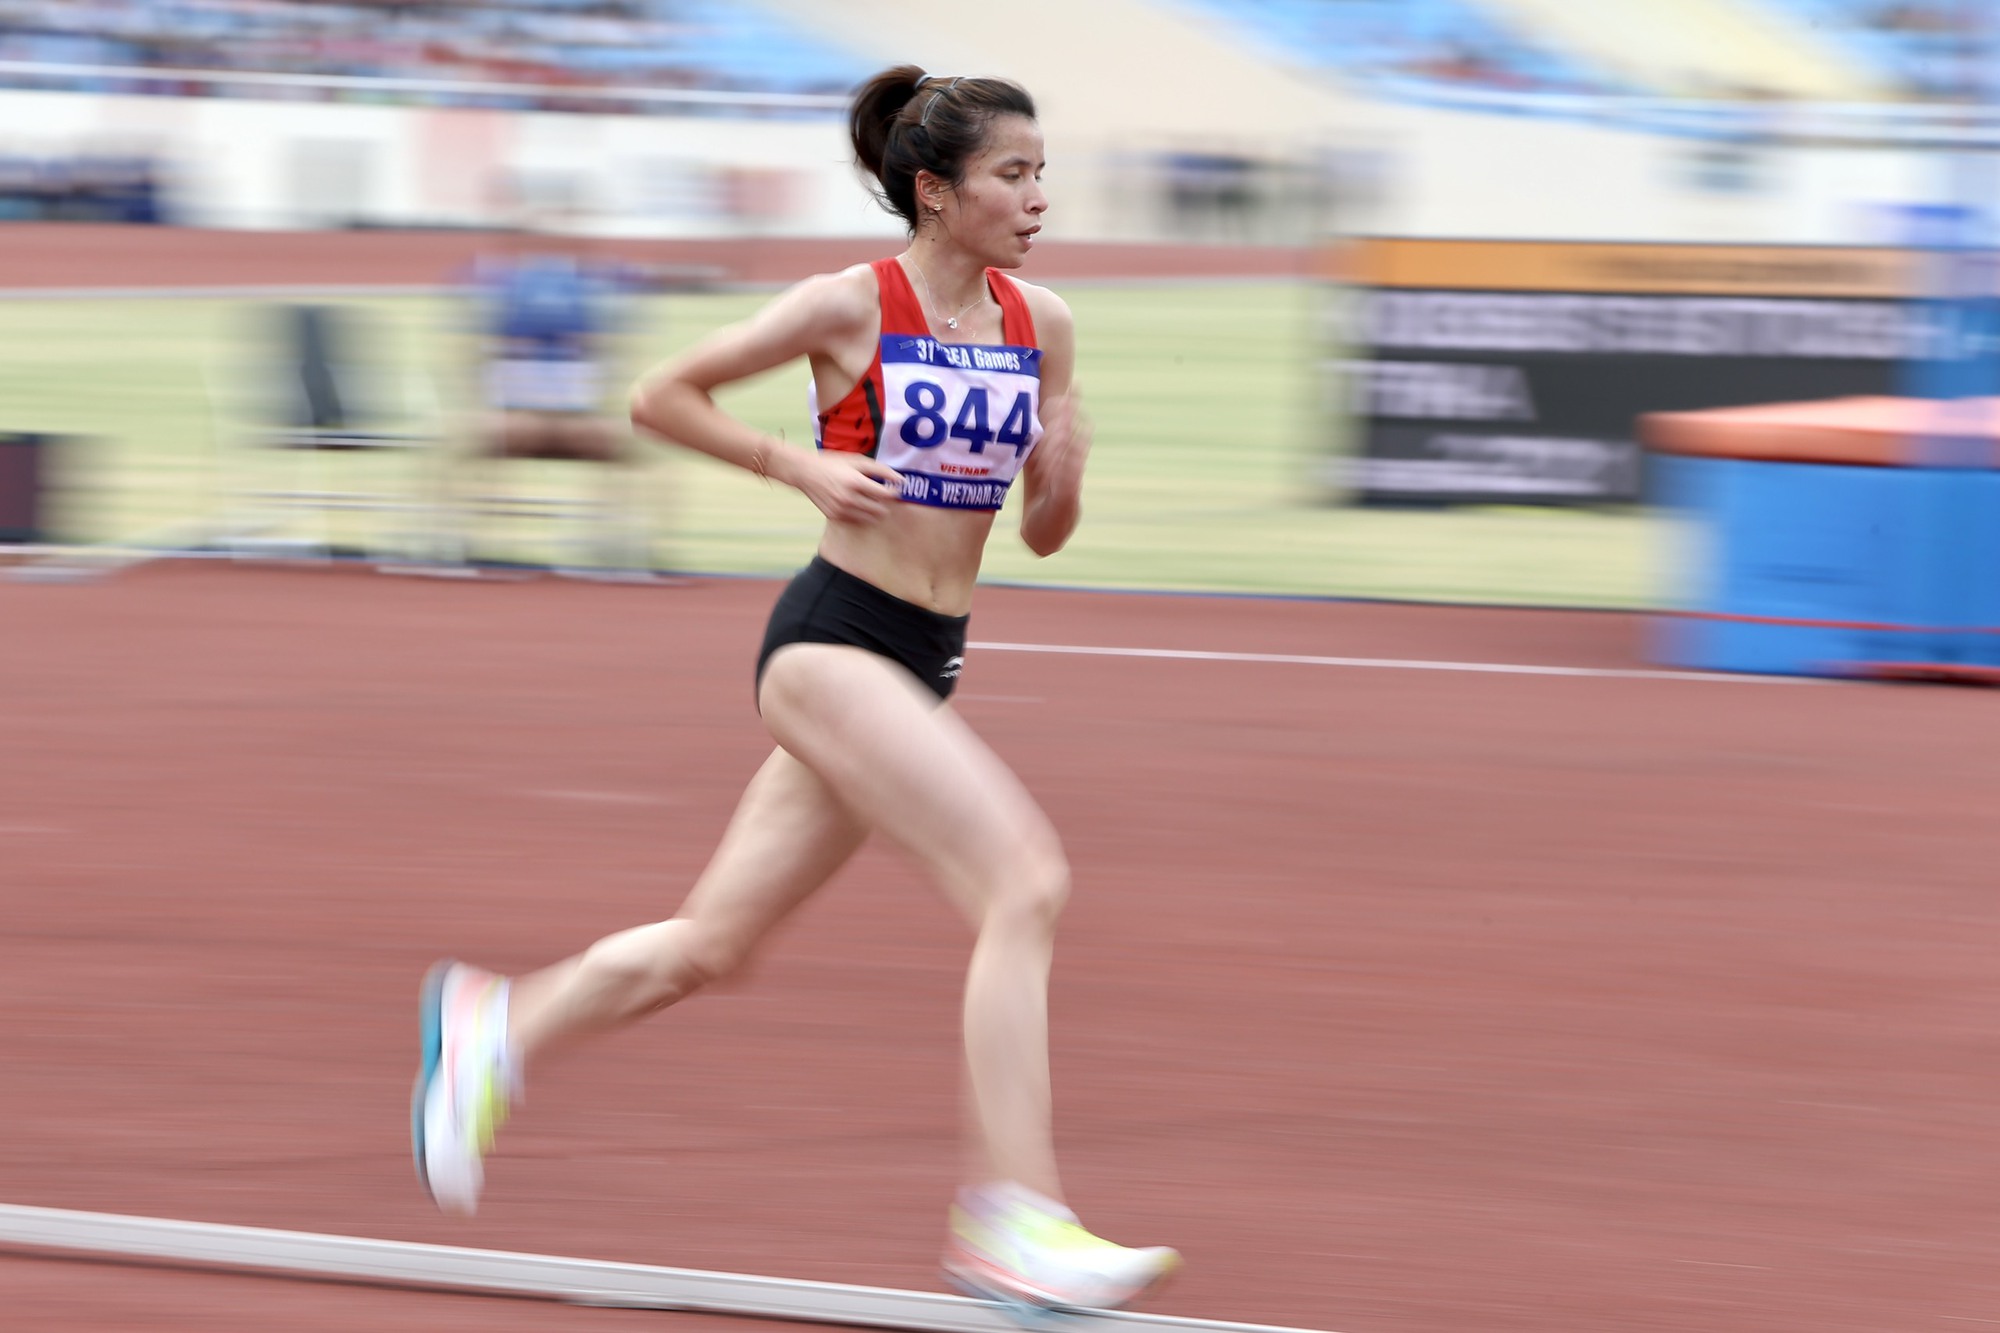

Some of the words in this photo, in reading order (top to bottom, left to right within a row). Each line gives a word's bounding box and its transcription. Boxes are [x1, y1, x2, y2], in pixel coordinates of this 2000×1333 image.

[972, 347, 1021, 371] Games
[900, 381, 1034, 459] 844
[940, 463, 989, 477] VIETNAM
[884, 473, 930, 500] NOI
[941, 480, 992, 505] VIETNAM
